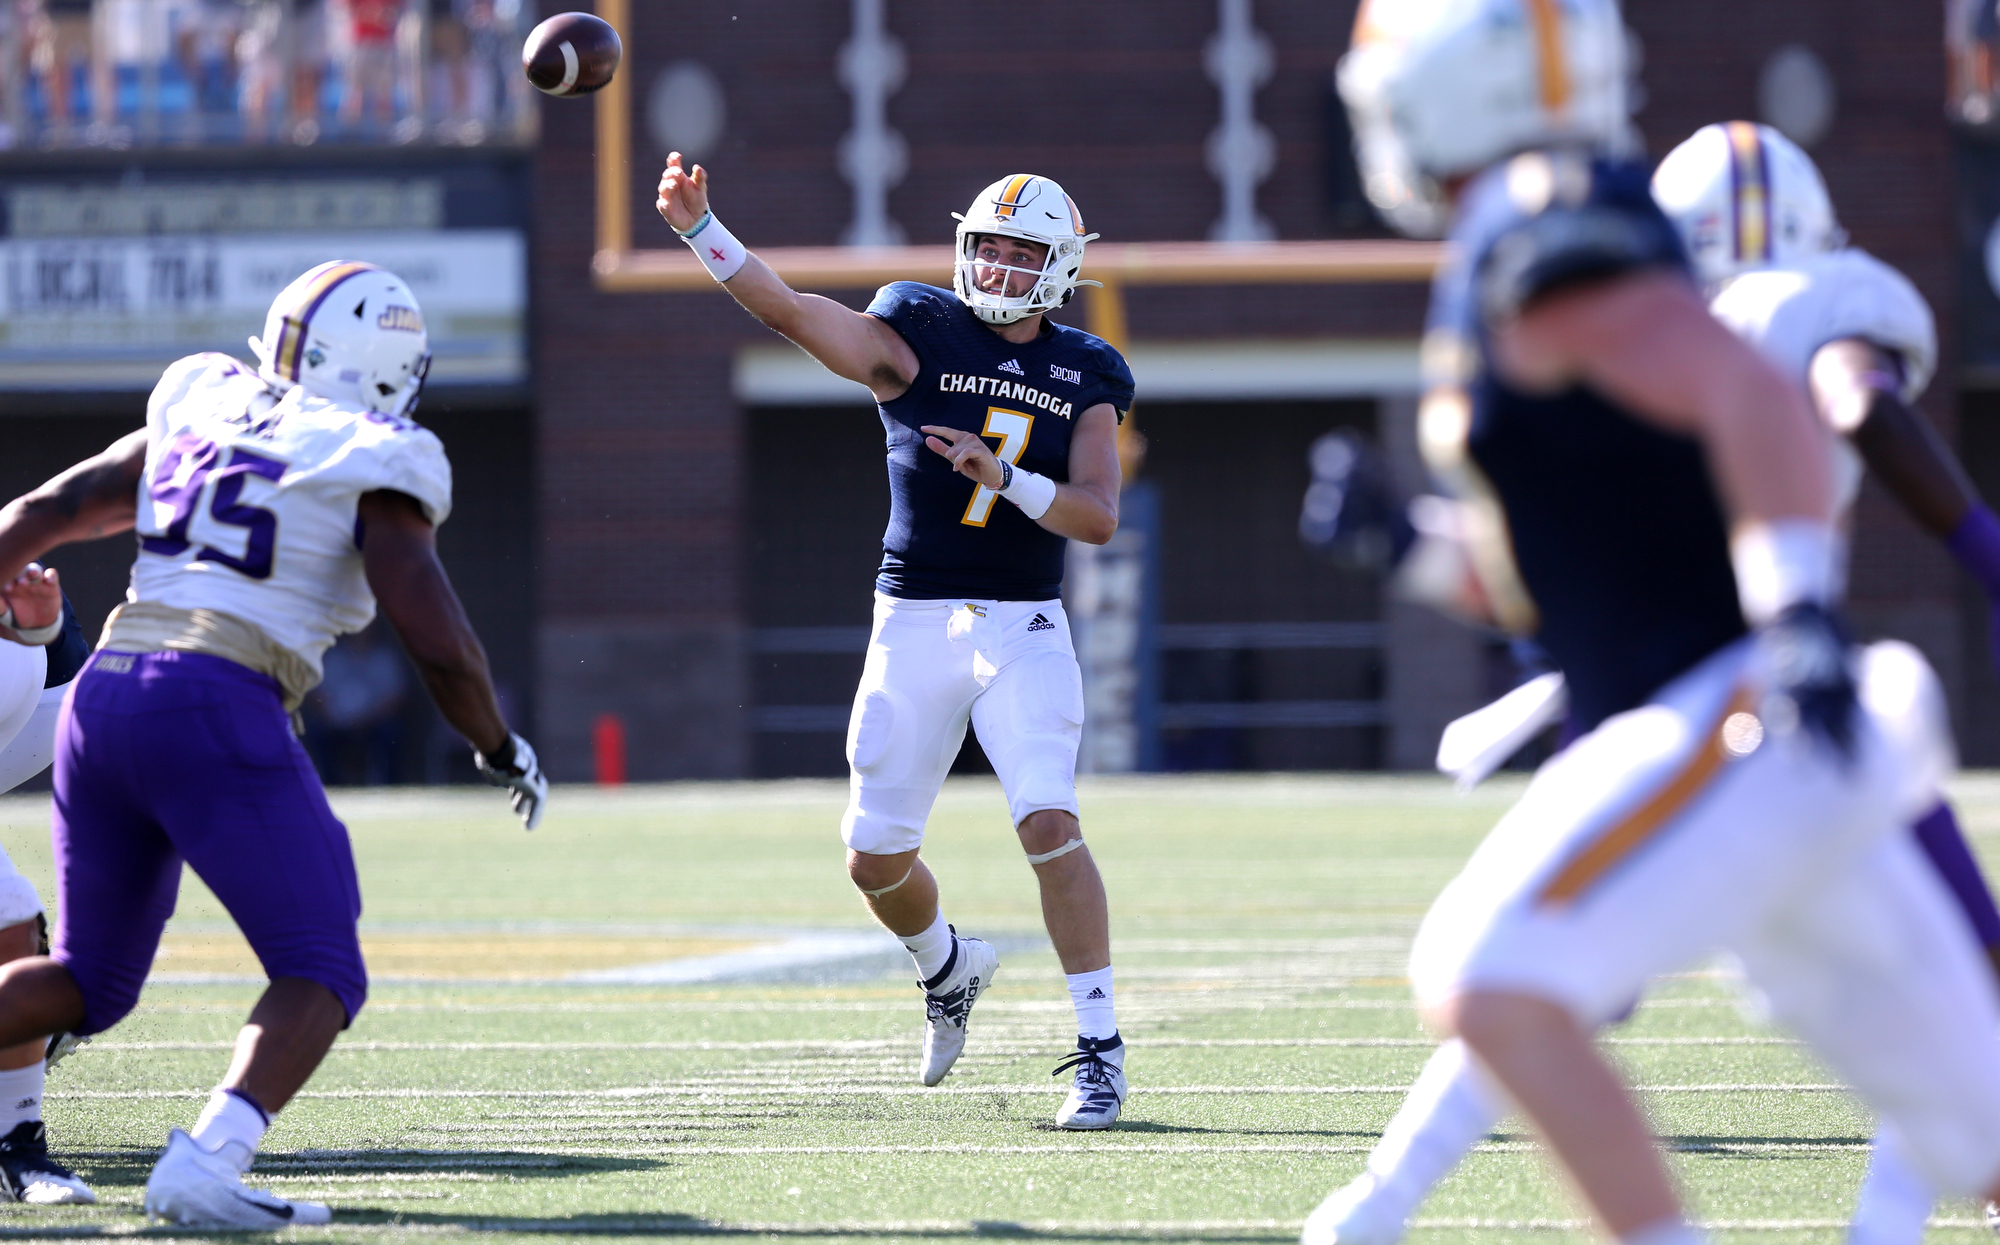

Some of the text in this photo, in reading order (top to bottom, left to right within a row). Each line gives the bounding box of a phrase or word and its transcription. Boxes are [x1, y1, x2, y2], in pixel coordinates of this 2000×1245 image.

[940, 373, 1073, 420] CHATTANOOGA
[998, 364, 1025, 376] adidas
[960, 406, 1035, 528] 7
[141, 433, 292, 581] 95
[1027, 623, 1055, 632] adidas
[963, 976, 980, 1035] didas
